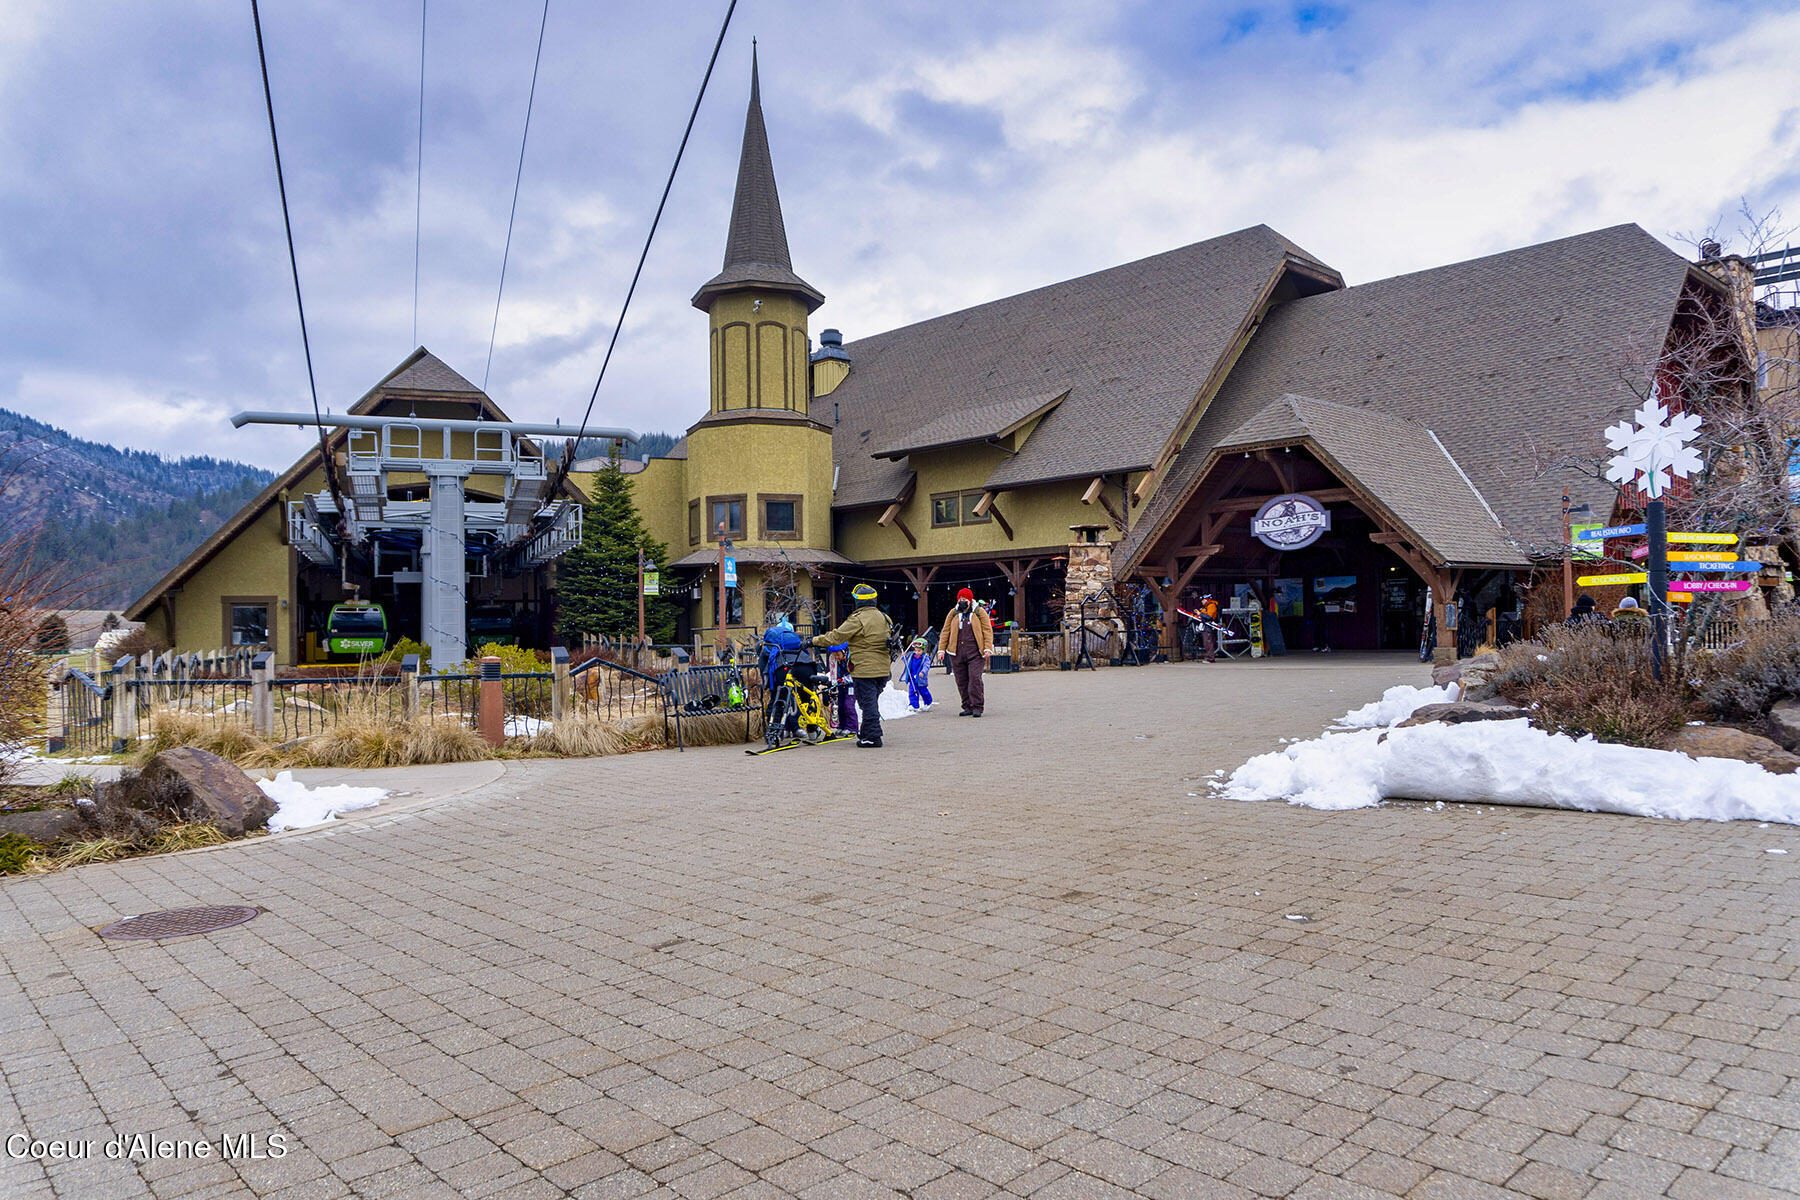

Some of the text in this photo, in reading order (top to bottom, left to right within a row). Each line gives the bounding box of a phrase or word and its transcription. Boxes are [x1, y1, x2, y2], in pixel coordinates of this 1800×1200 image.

[1261, 513, 1320, 528] NOAH'S
[1590, 530, 1602, 538] REAL
[1699, 562, 1735, 570] TICKETING
